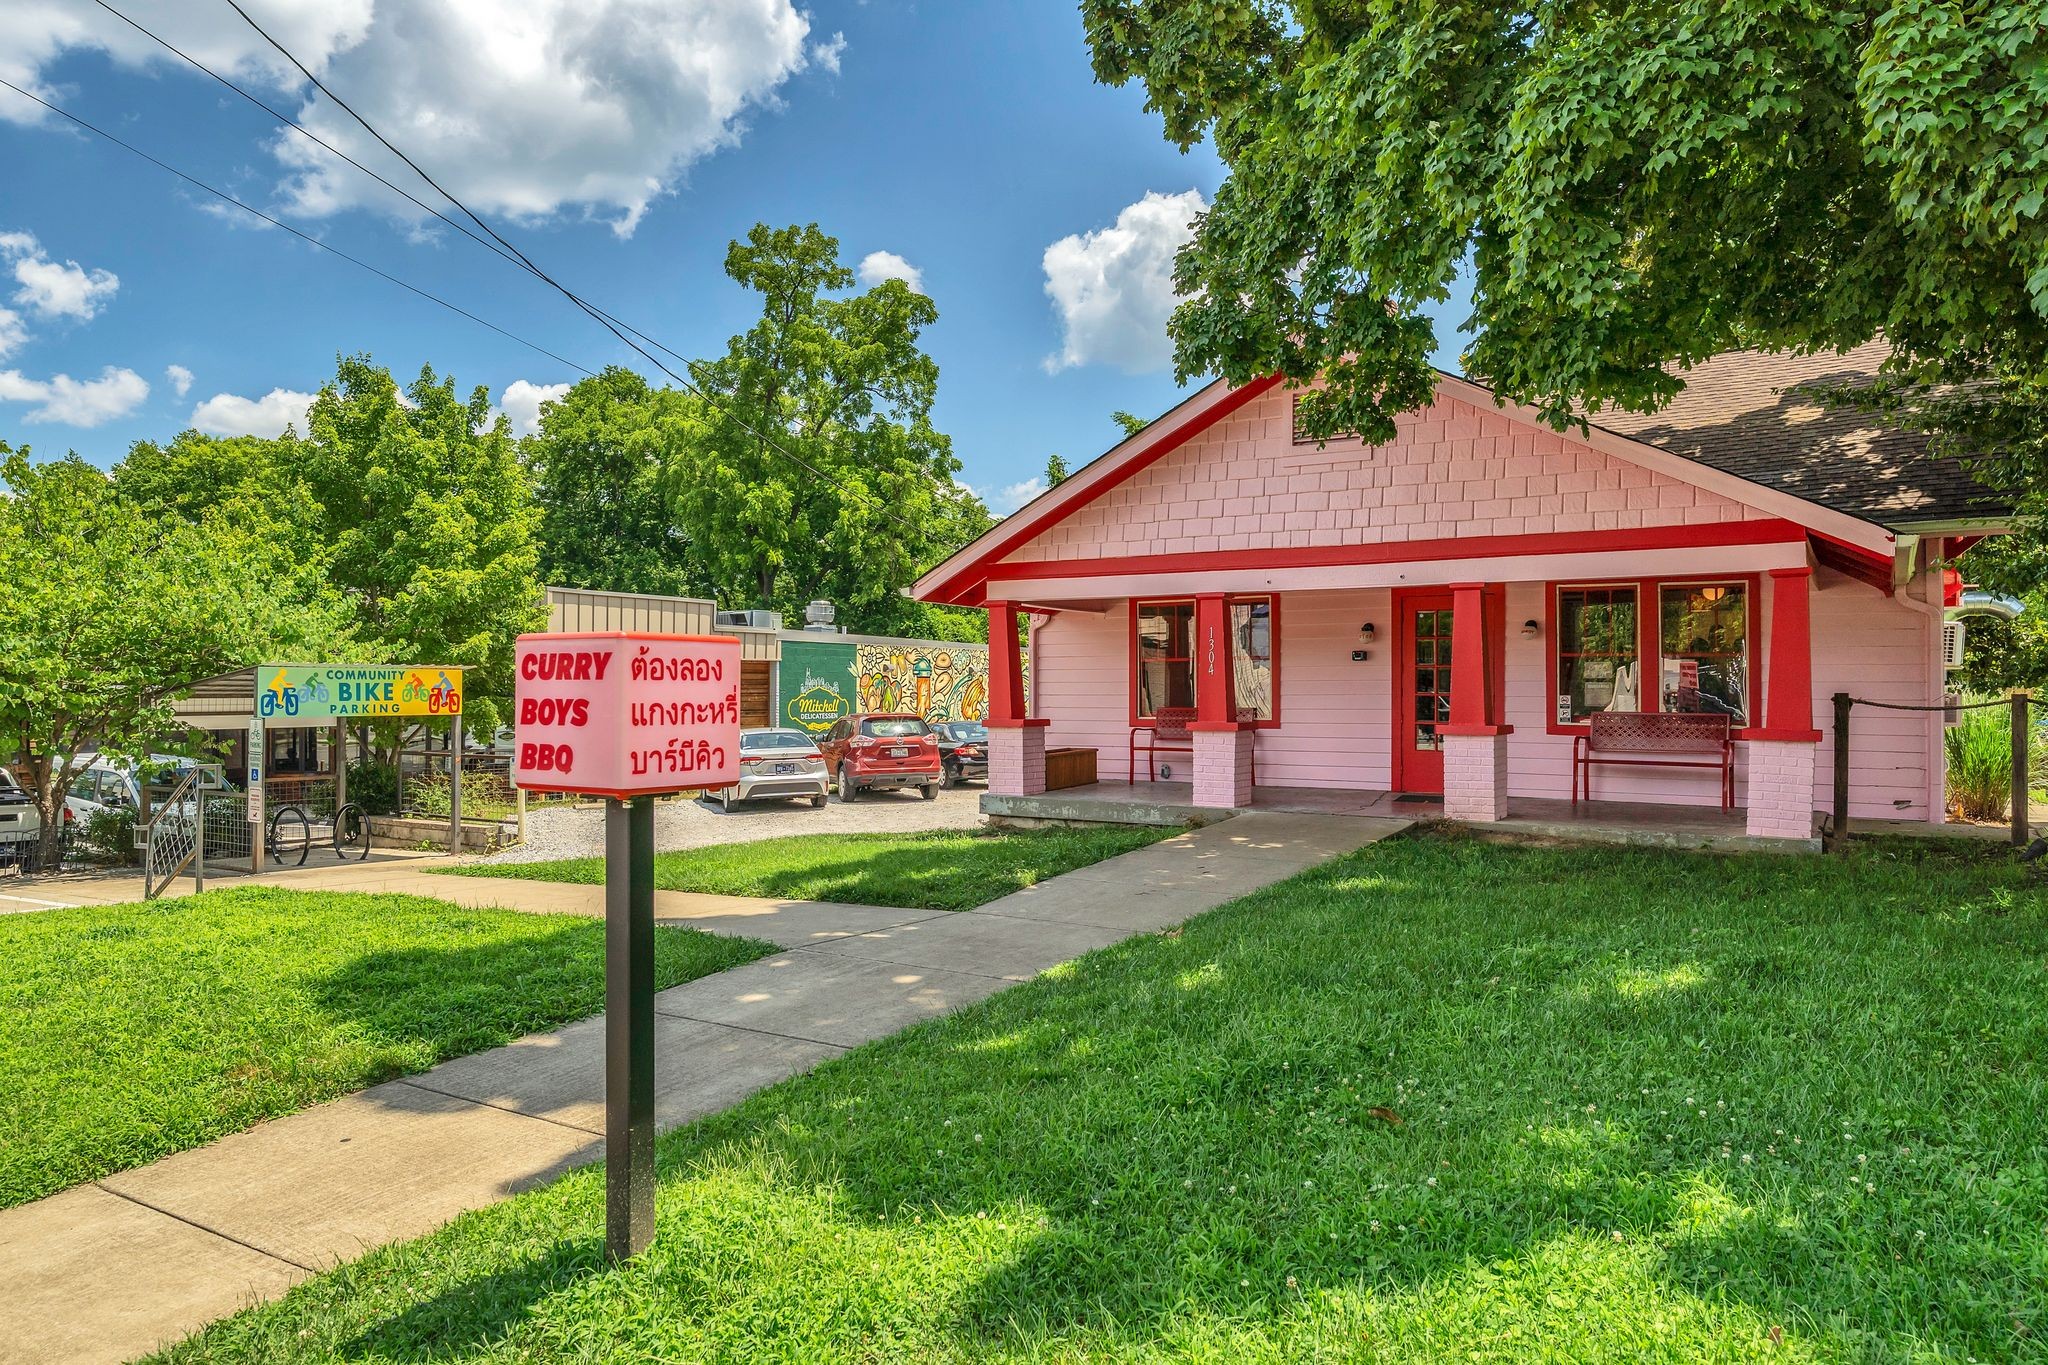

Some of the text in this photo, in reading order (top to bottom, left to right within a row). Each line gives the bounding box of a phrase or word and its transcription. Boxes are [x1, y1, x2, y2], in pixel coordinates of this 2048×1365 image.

[326, 670, 406, 681] COMMUNITY
[521, 651, 613, 681] CURRY
[631, 646, 723, 681] ต้องลอง
[338, 682, 394, 702] BIKE
[631, 685, 738, 727] แกงกะหรี่
[799, 699, 840, 712] Mitchell
[330, 703, 400, 714] PARKING
[520, 698, 590, 727] BOYS
[800, 712, 838, 720] DELICATESSEN
[519, 742, 574, 775] BBQ
[630, 737, 725, 775] บาร์บีคิว
